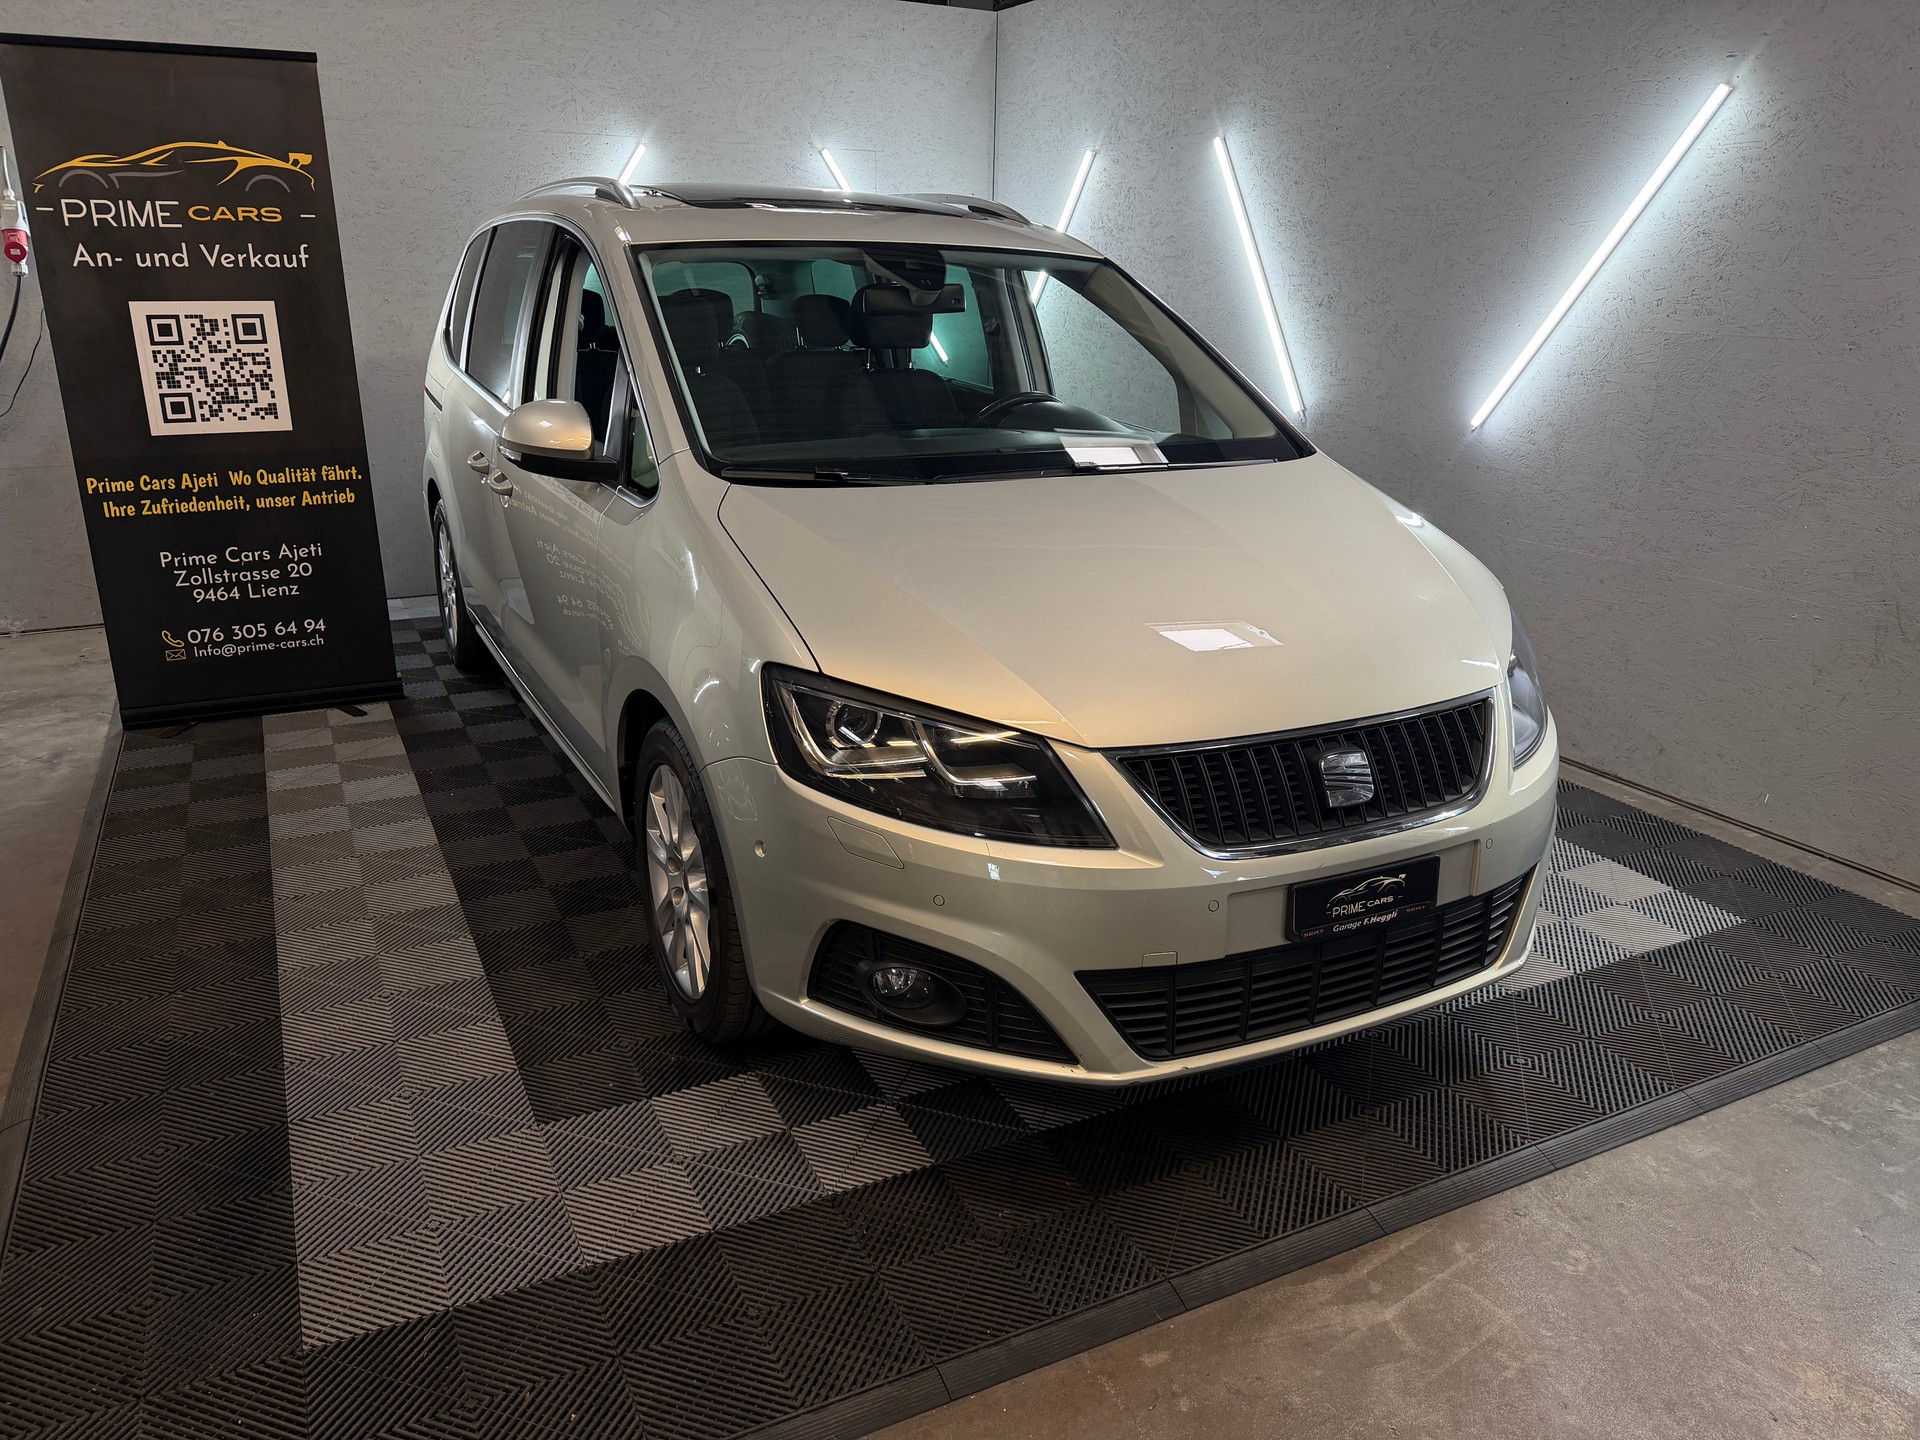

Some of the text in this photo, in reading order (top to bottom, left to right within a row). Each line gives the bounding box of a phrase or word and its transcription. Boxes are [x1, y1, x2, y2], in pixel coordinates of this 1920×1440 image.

[60, 198, 283, 228] PRIME CARS
[73, 242, 310, 269] An- und Verkauf
[85, 465, 363, 495] Prime Cars Ajeti Wo Qualität fährt.
[103, 488, 355, 518] Ihre Zufriedenheit, unser Antrieb
[159, 543, 323, 568] Prime Cars Ajeti
[173, 562, 313, 587] Zollstrasse 20
[193, 583, 300, 604] 9464 Lienz
[187, 618, 326, 645] 076 305 64 94
[193, 635, 325, 658] Info@prime-cars.ch
[1332, 895, 1394, 918] PRIME CARS
[1333, 920, 1362, 932] Garage
